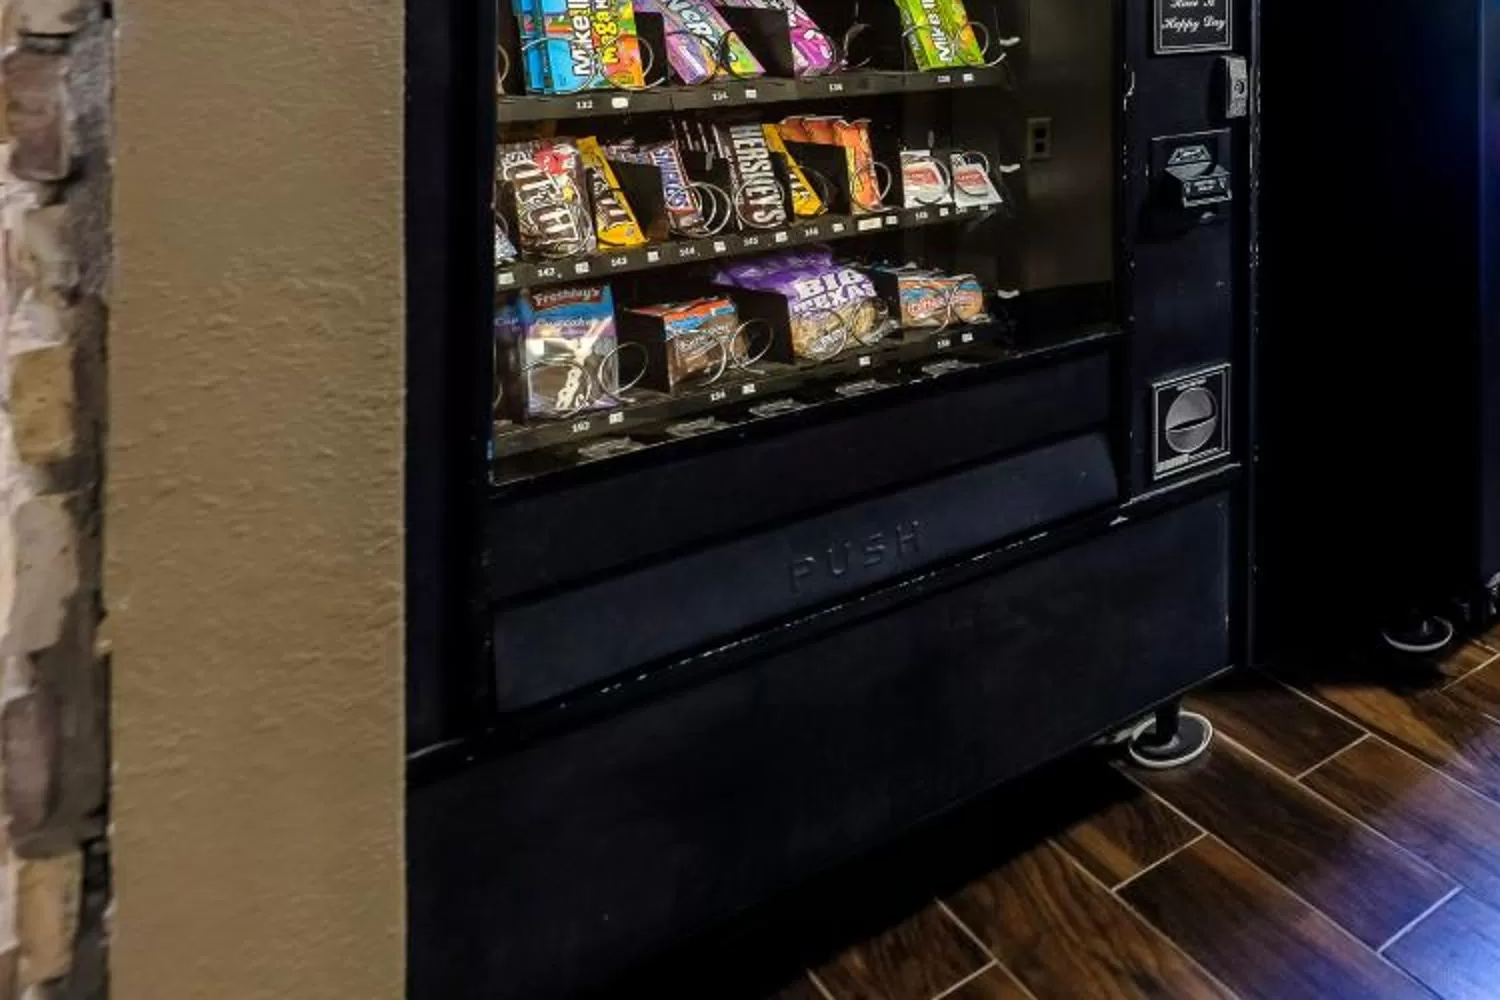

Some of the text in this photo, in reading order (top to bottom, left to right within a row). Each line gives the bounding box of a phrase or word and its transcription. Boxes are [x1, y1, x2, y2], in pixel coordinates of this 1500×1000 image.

[572, 15, 593, 75] Mike
[1161, 15, 1225, 33] Happy Day
[789, 520, 927, 593] PUSH
